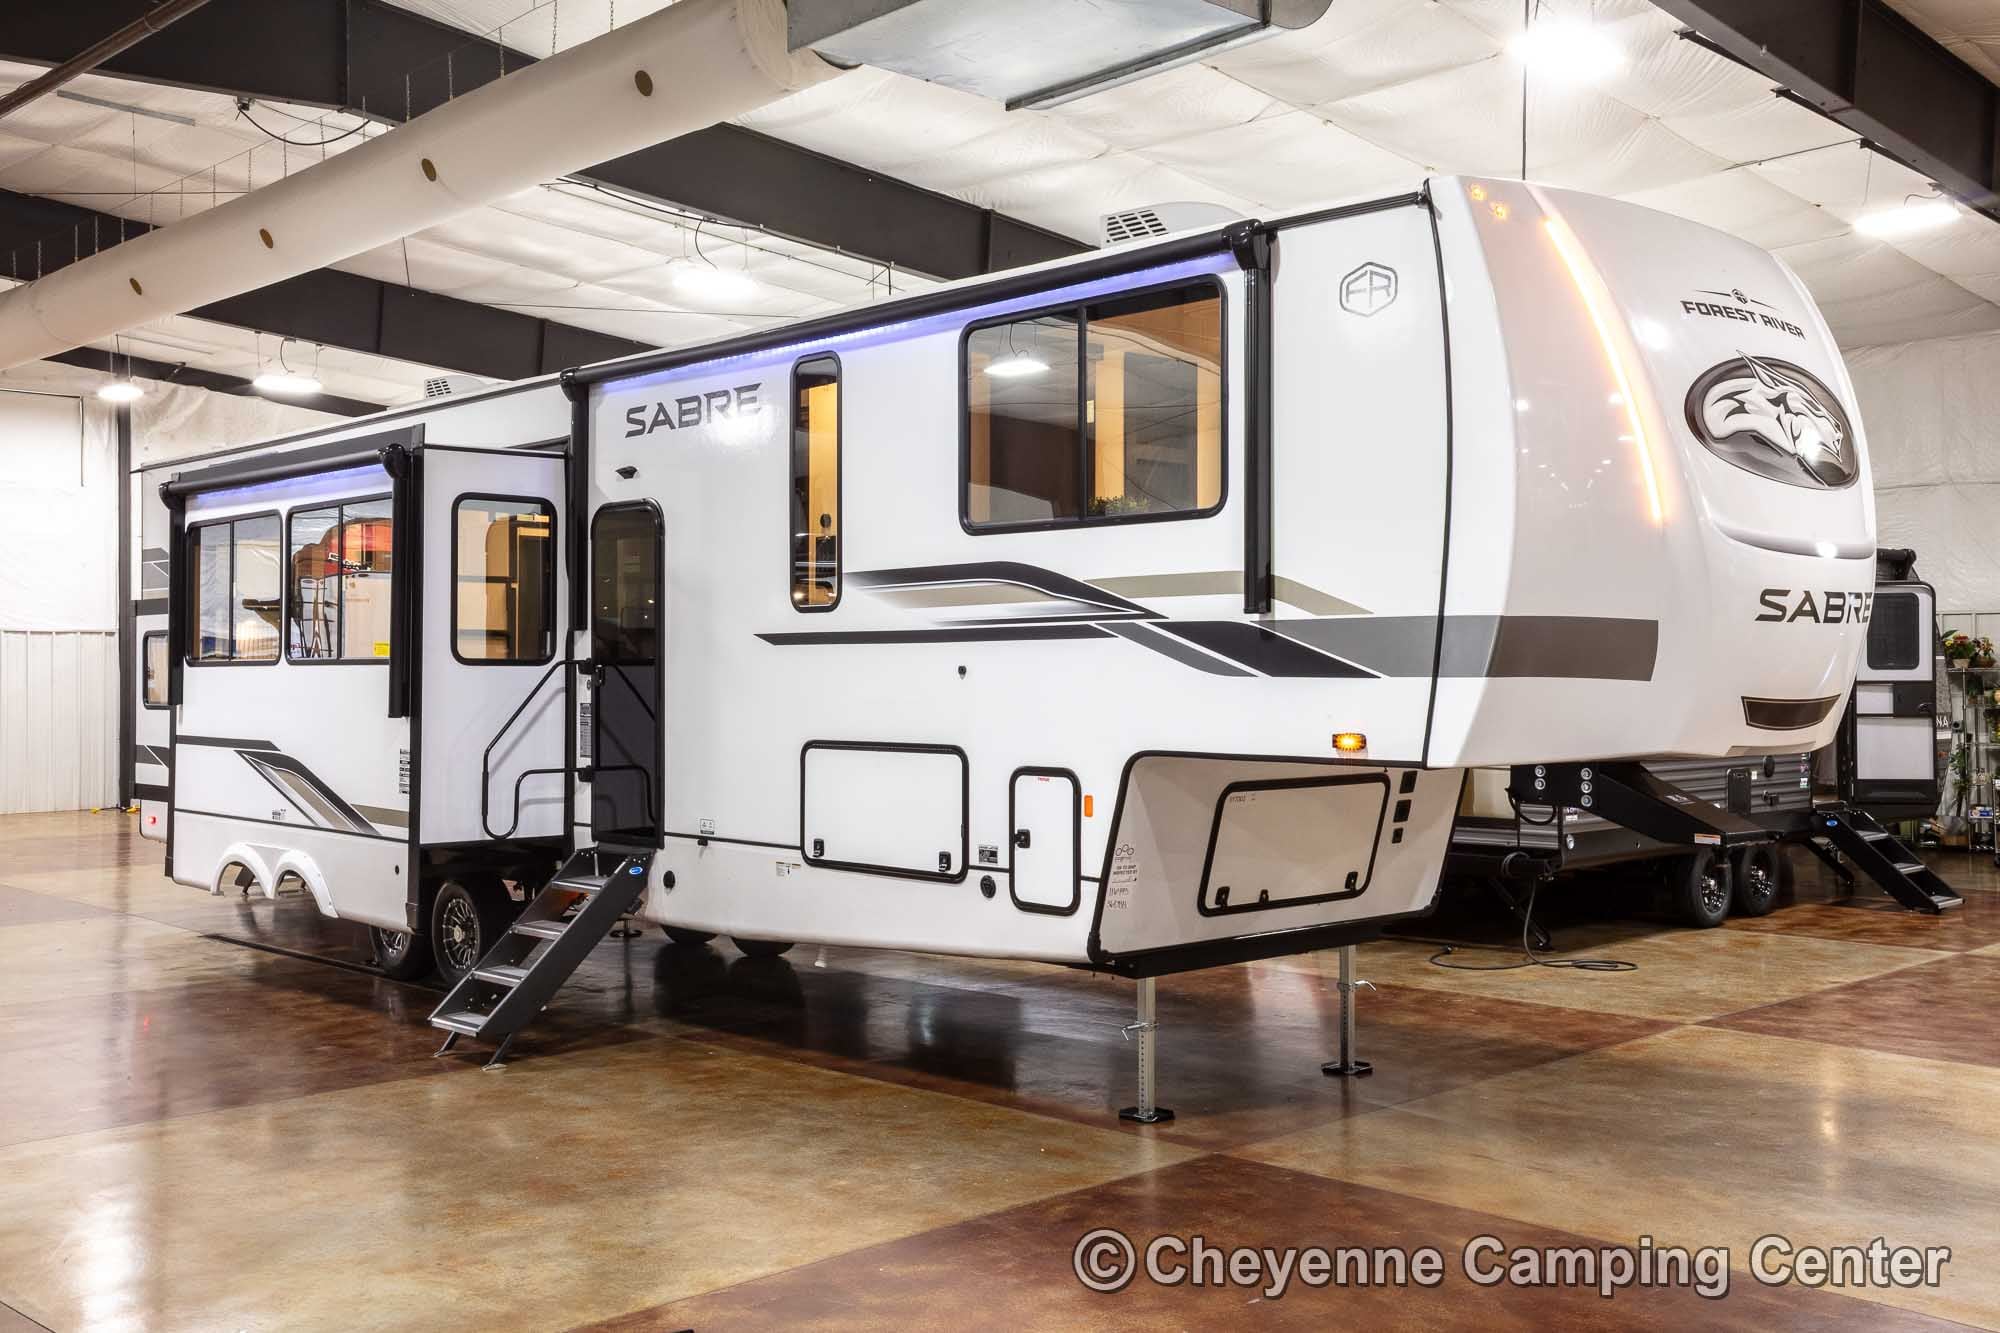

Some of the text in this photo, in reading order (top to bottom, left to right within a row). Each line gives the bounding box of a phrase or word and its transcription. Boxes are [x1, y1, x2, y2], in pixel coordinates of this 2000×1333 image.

[1680, 300, 1807, 341] FOREST RIVER
[624, 382, 763, 439] SABRE
[1754, 588, 1873, 624] SABRE
